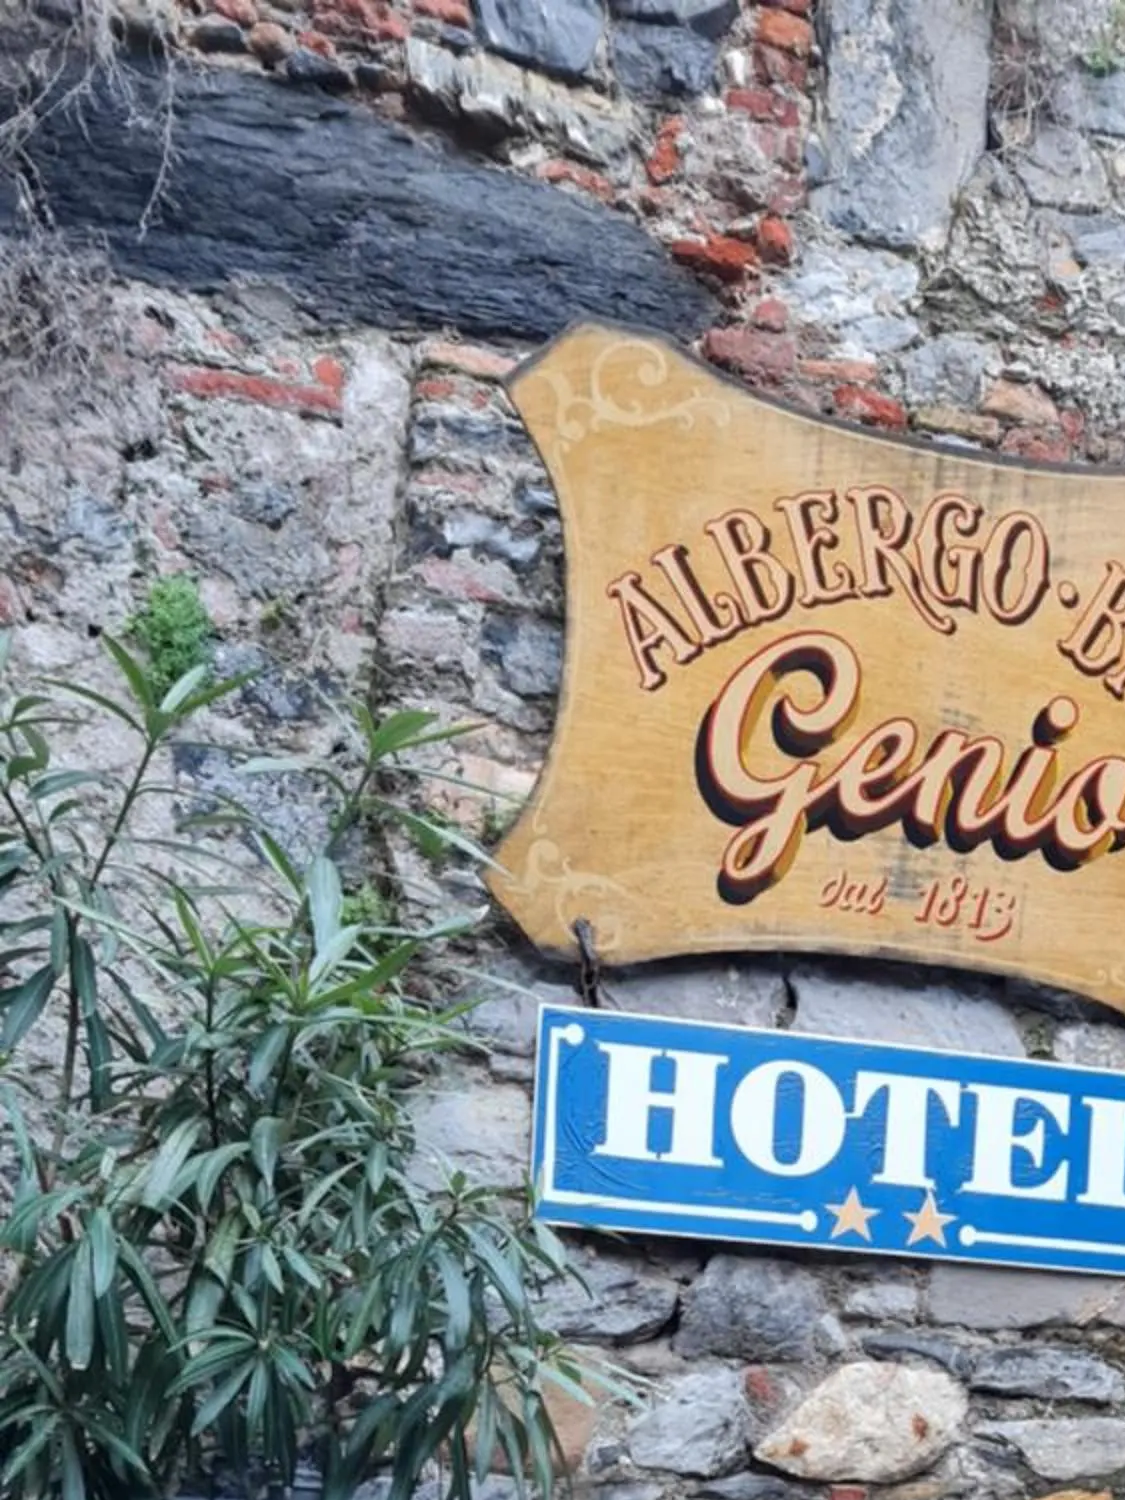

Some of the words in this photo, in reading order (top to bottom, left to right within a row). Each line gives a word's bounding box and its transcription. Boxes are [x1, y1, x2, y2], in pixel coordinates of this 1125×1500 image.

[608, 485, 1051, 690] ALBERGO
[817, 869, 888, 914] dal
[914, 877, 1015, 941] 1813
